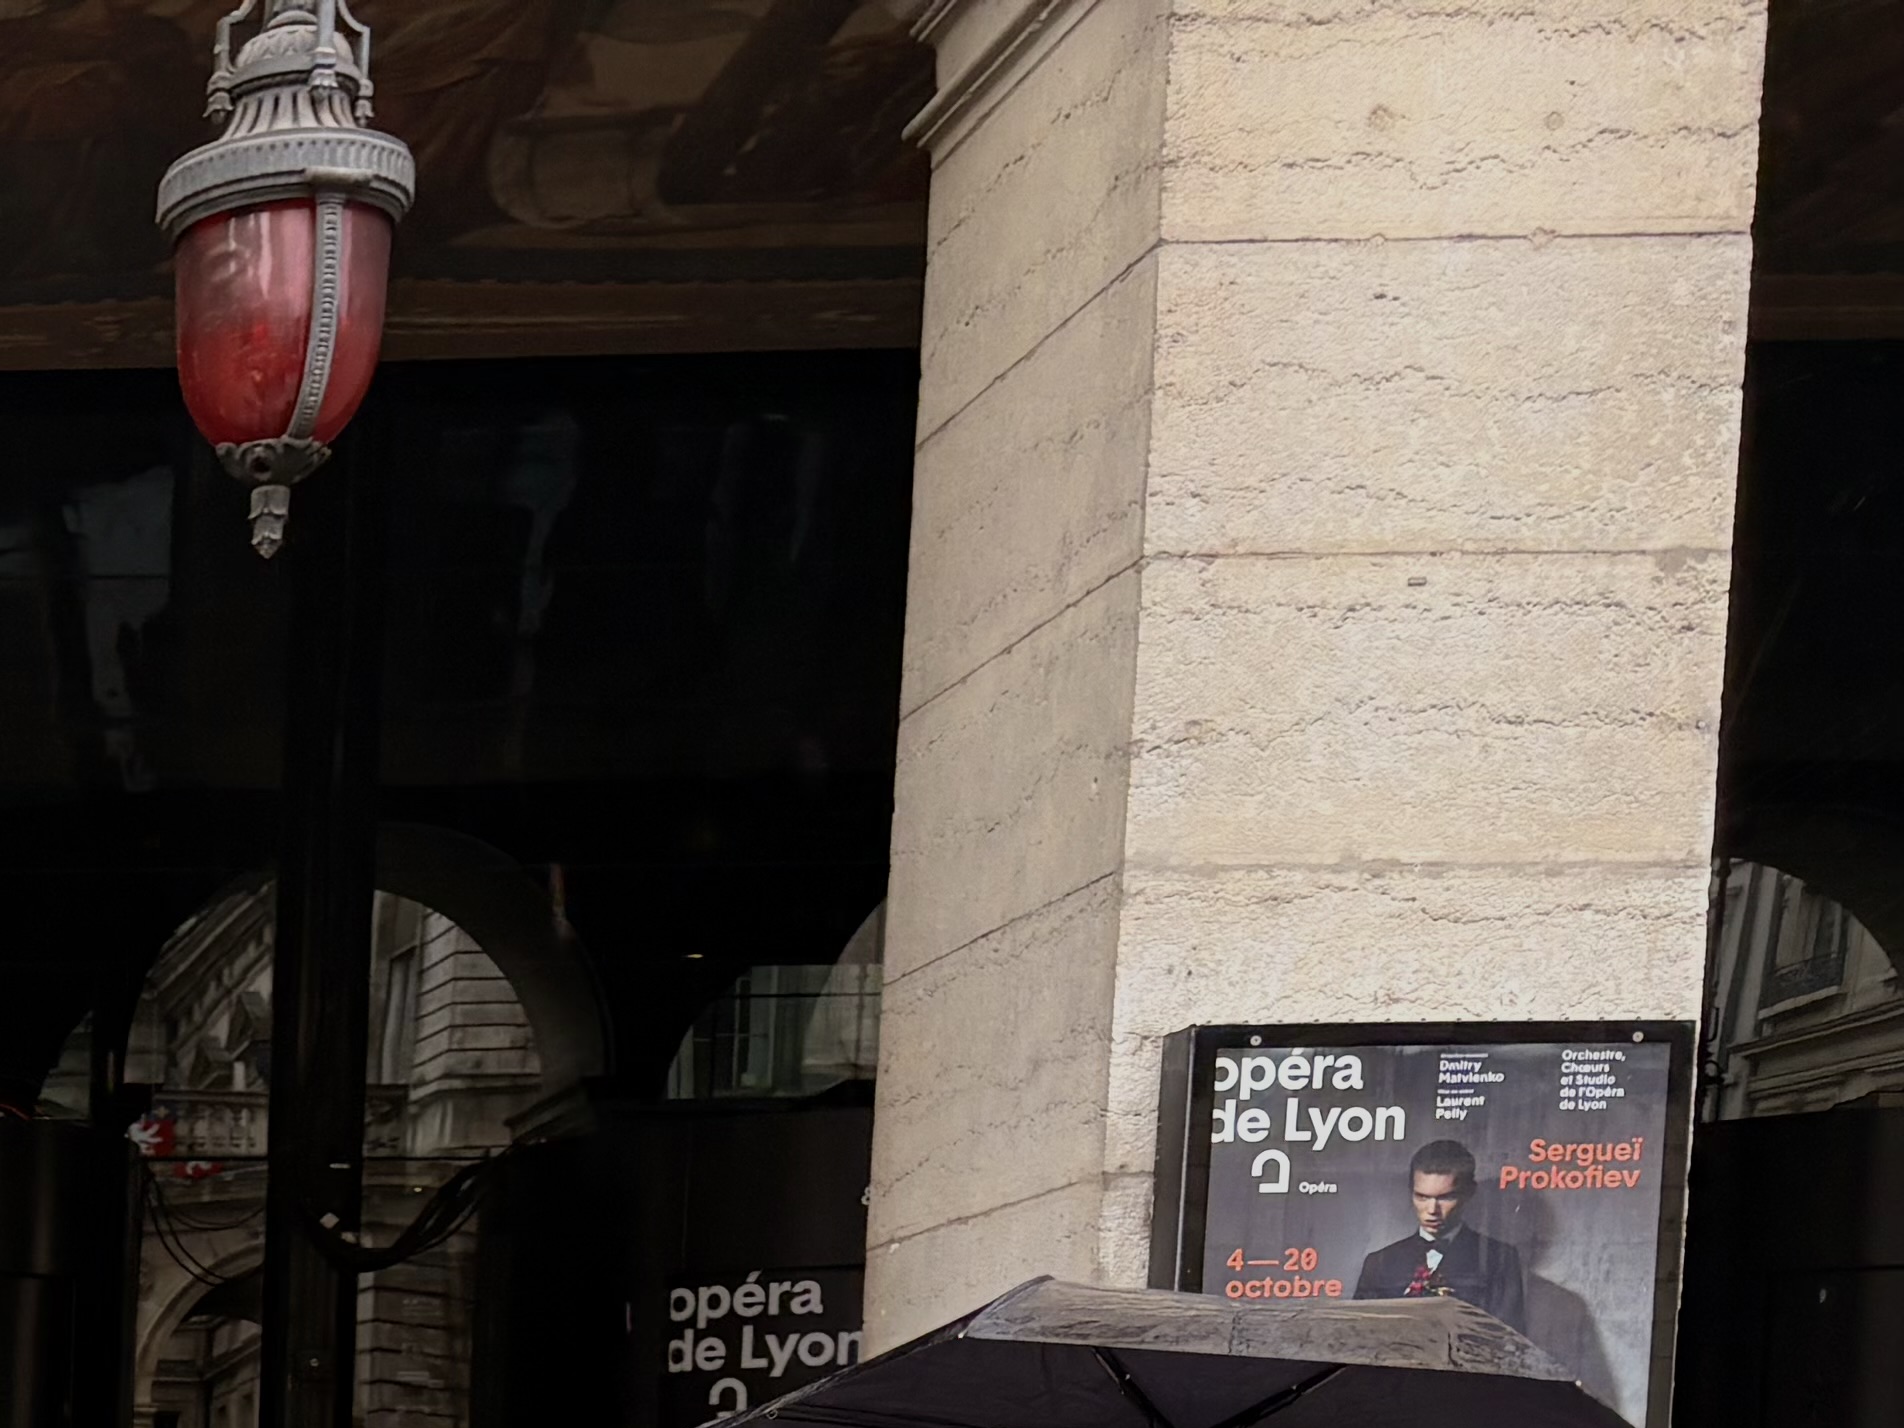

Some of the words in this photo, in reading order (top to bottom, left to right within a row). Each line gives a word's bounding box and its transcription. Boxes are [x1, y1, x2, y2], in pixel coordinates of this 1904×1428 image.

[1561, 1049, 1627, 1062] Orchestre,
[1439, 1060, 1483, 1073] Dmitry
[1214, 1049, 1365, 1100] opéra
[1438, 1072, 1505, 1084] Matvienko
[1560, 1074, 1574, 1086] et
[1575, 1074, 1617, 1086] Studio
[1559, 1087, 1576, 1098] de
[1578, 1086, 1625, 1099] l'Opéra
[1436, 1096, 1486, 1107] Laurent
[1559, 1099, 1576, 1111] de
[1578, 1099, 1607, 1112] Lyon
[1211, 1099, 1272, 1144] de
[1284, 1097, 1406, 1151] Lyon
[1528, 1137, 1644, 1167] Sergueï
[1499, 1165, 1642, 1190] Prokofiev
[1298, 1181, 1339, 1195] Opéra
[1224, 1275, 1343, 1300] octobre
[669, 1270, 824, 1330] opéra
[667, 1328, 727, 1374] de
